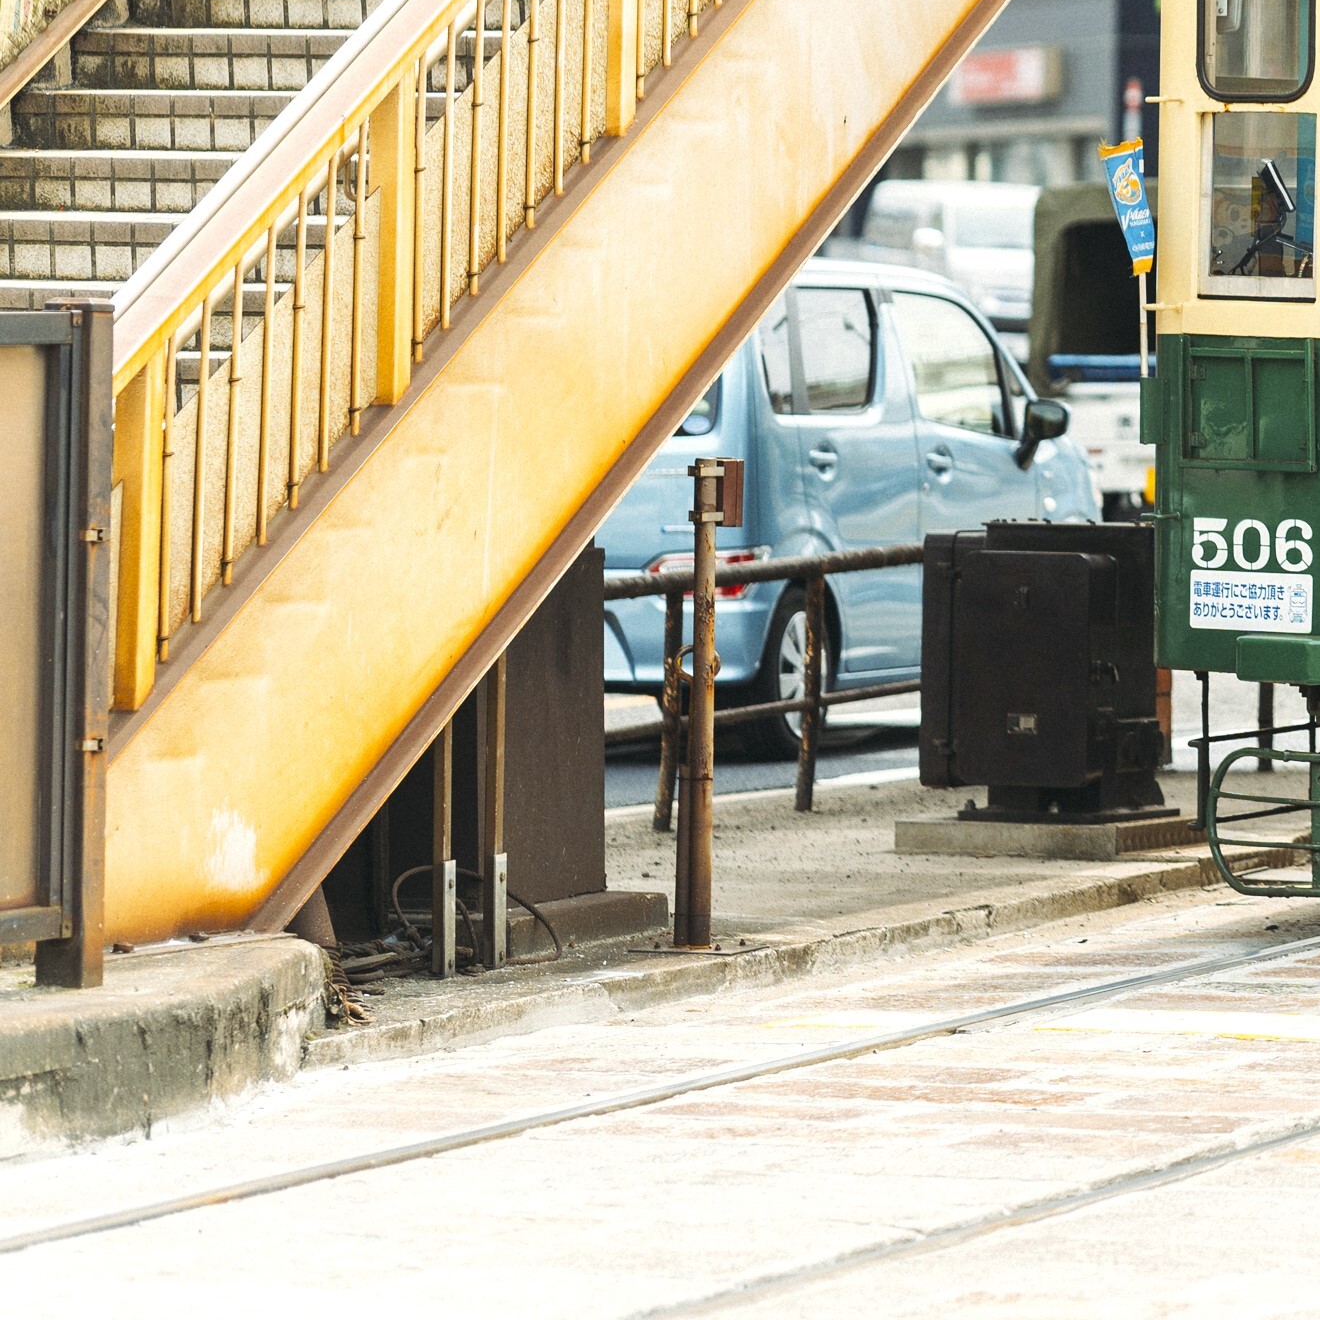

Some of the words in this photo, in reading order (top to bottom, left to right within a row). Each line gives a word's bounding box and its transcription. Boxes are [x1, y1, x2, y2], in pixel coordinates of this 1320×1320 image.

[1191, 517, 1313, 572] 506
[1193, 581, 1285, 601] 電車運行にご協力頂き
[1193, 601, 1284, 621] ありがとうございます。
